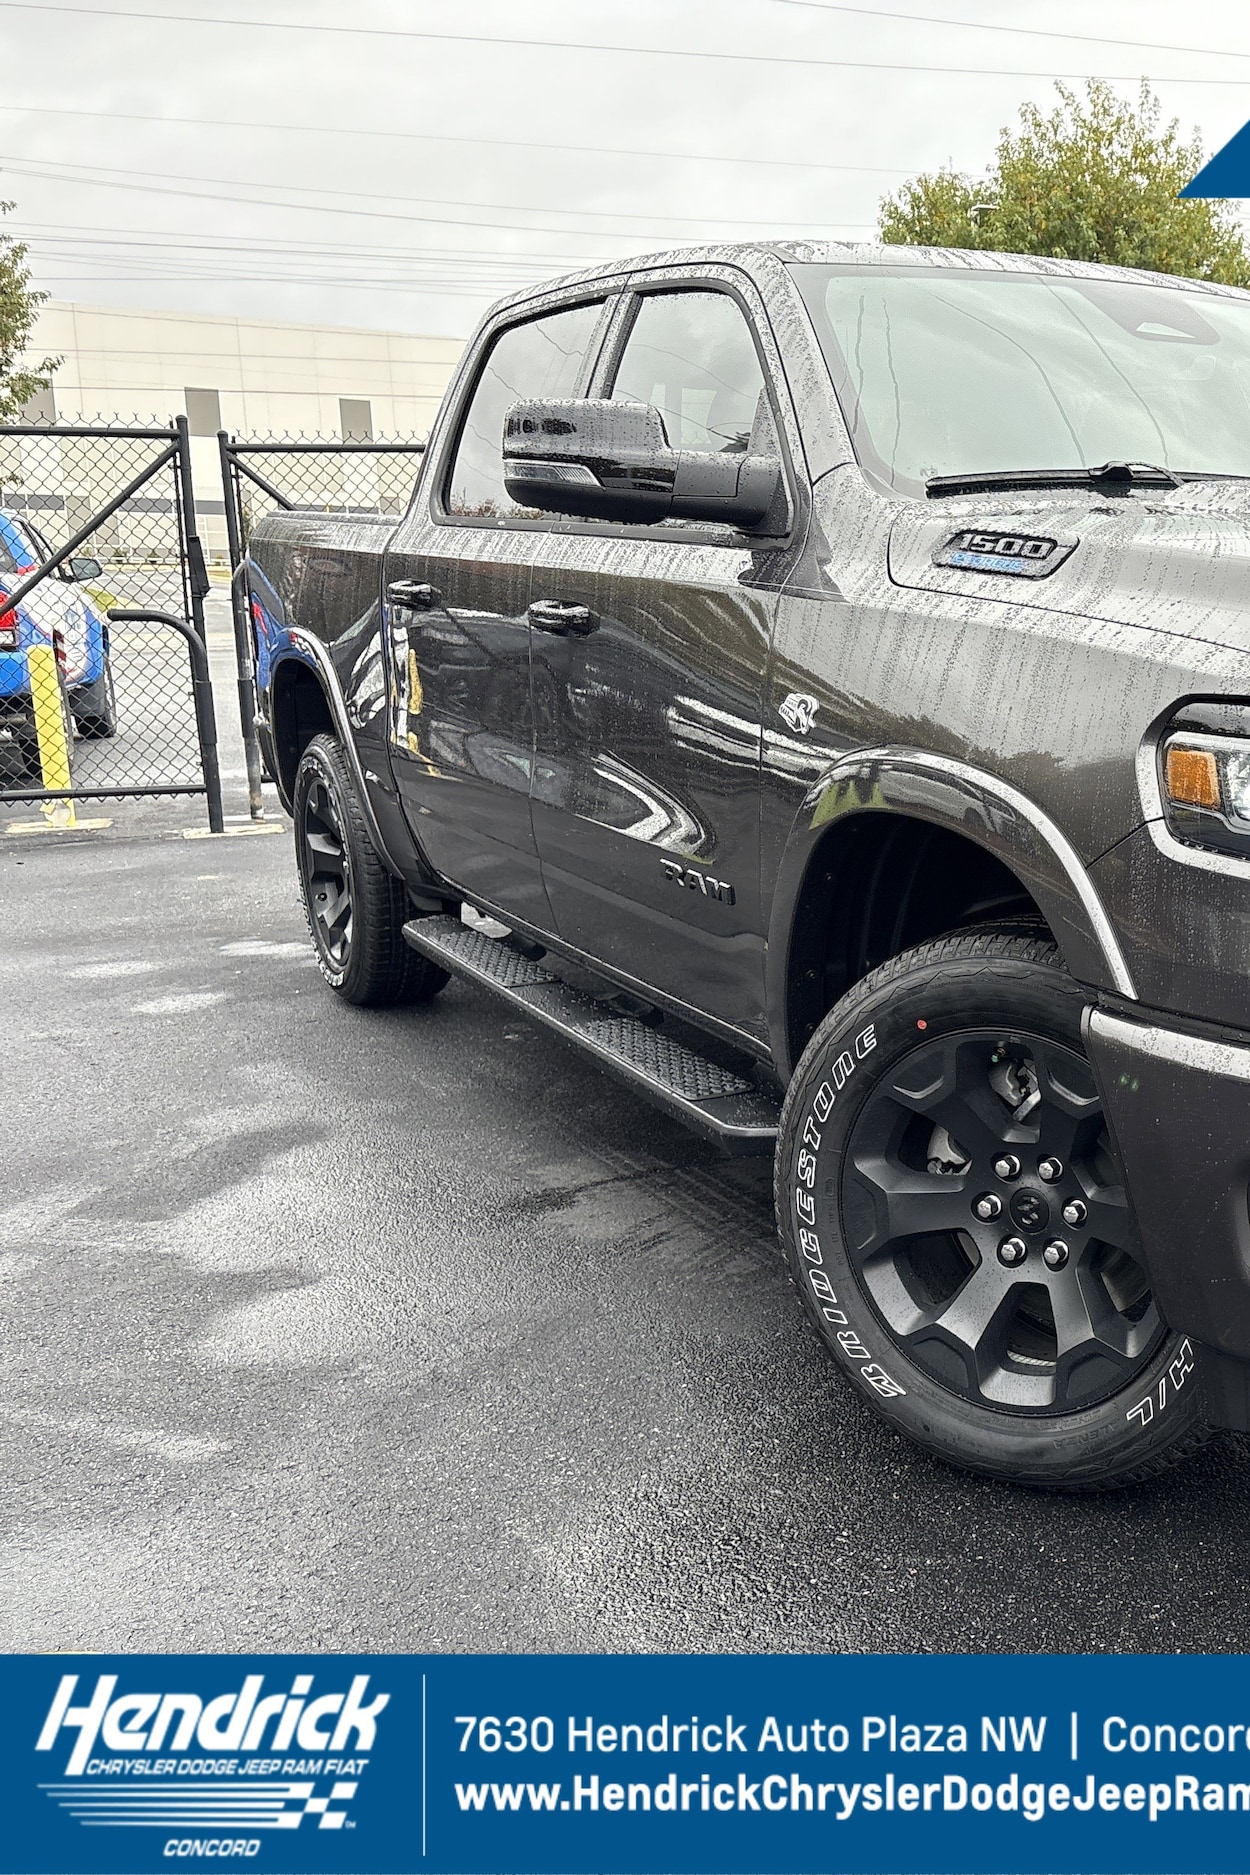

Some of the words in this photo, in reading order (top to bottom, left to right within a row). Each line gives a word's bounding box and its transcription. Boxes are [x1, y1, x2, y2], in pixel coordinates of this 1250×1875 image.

[960, 533, 1051, 558] 1500
[660, 858, 736, 906] RAM
[797, 1023, 906, 1398] BRIDGESTONE
